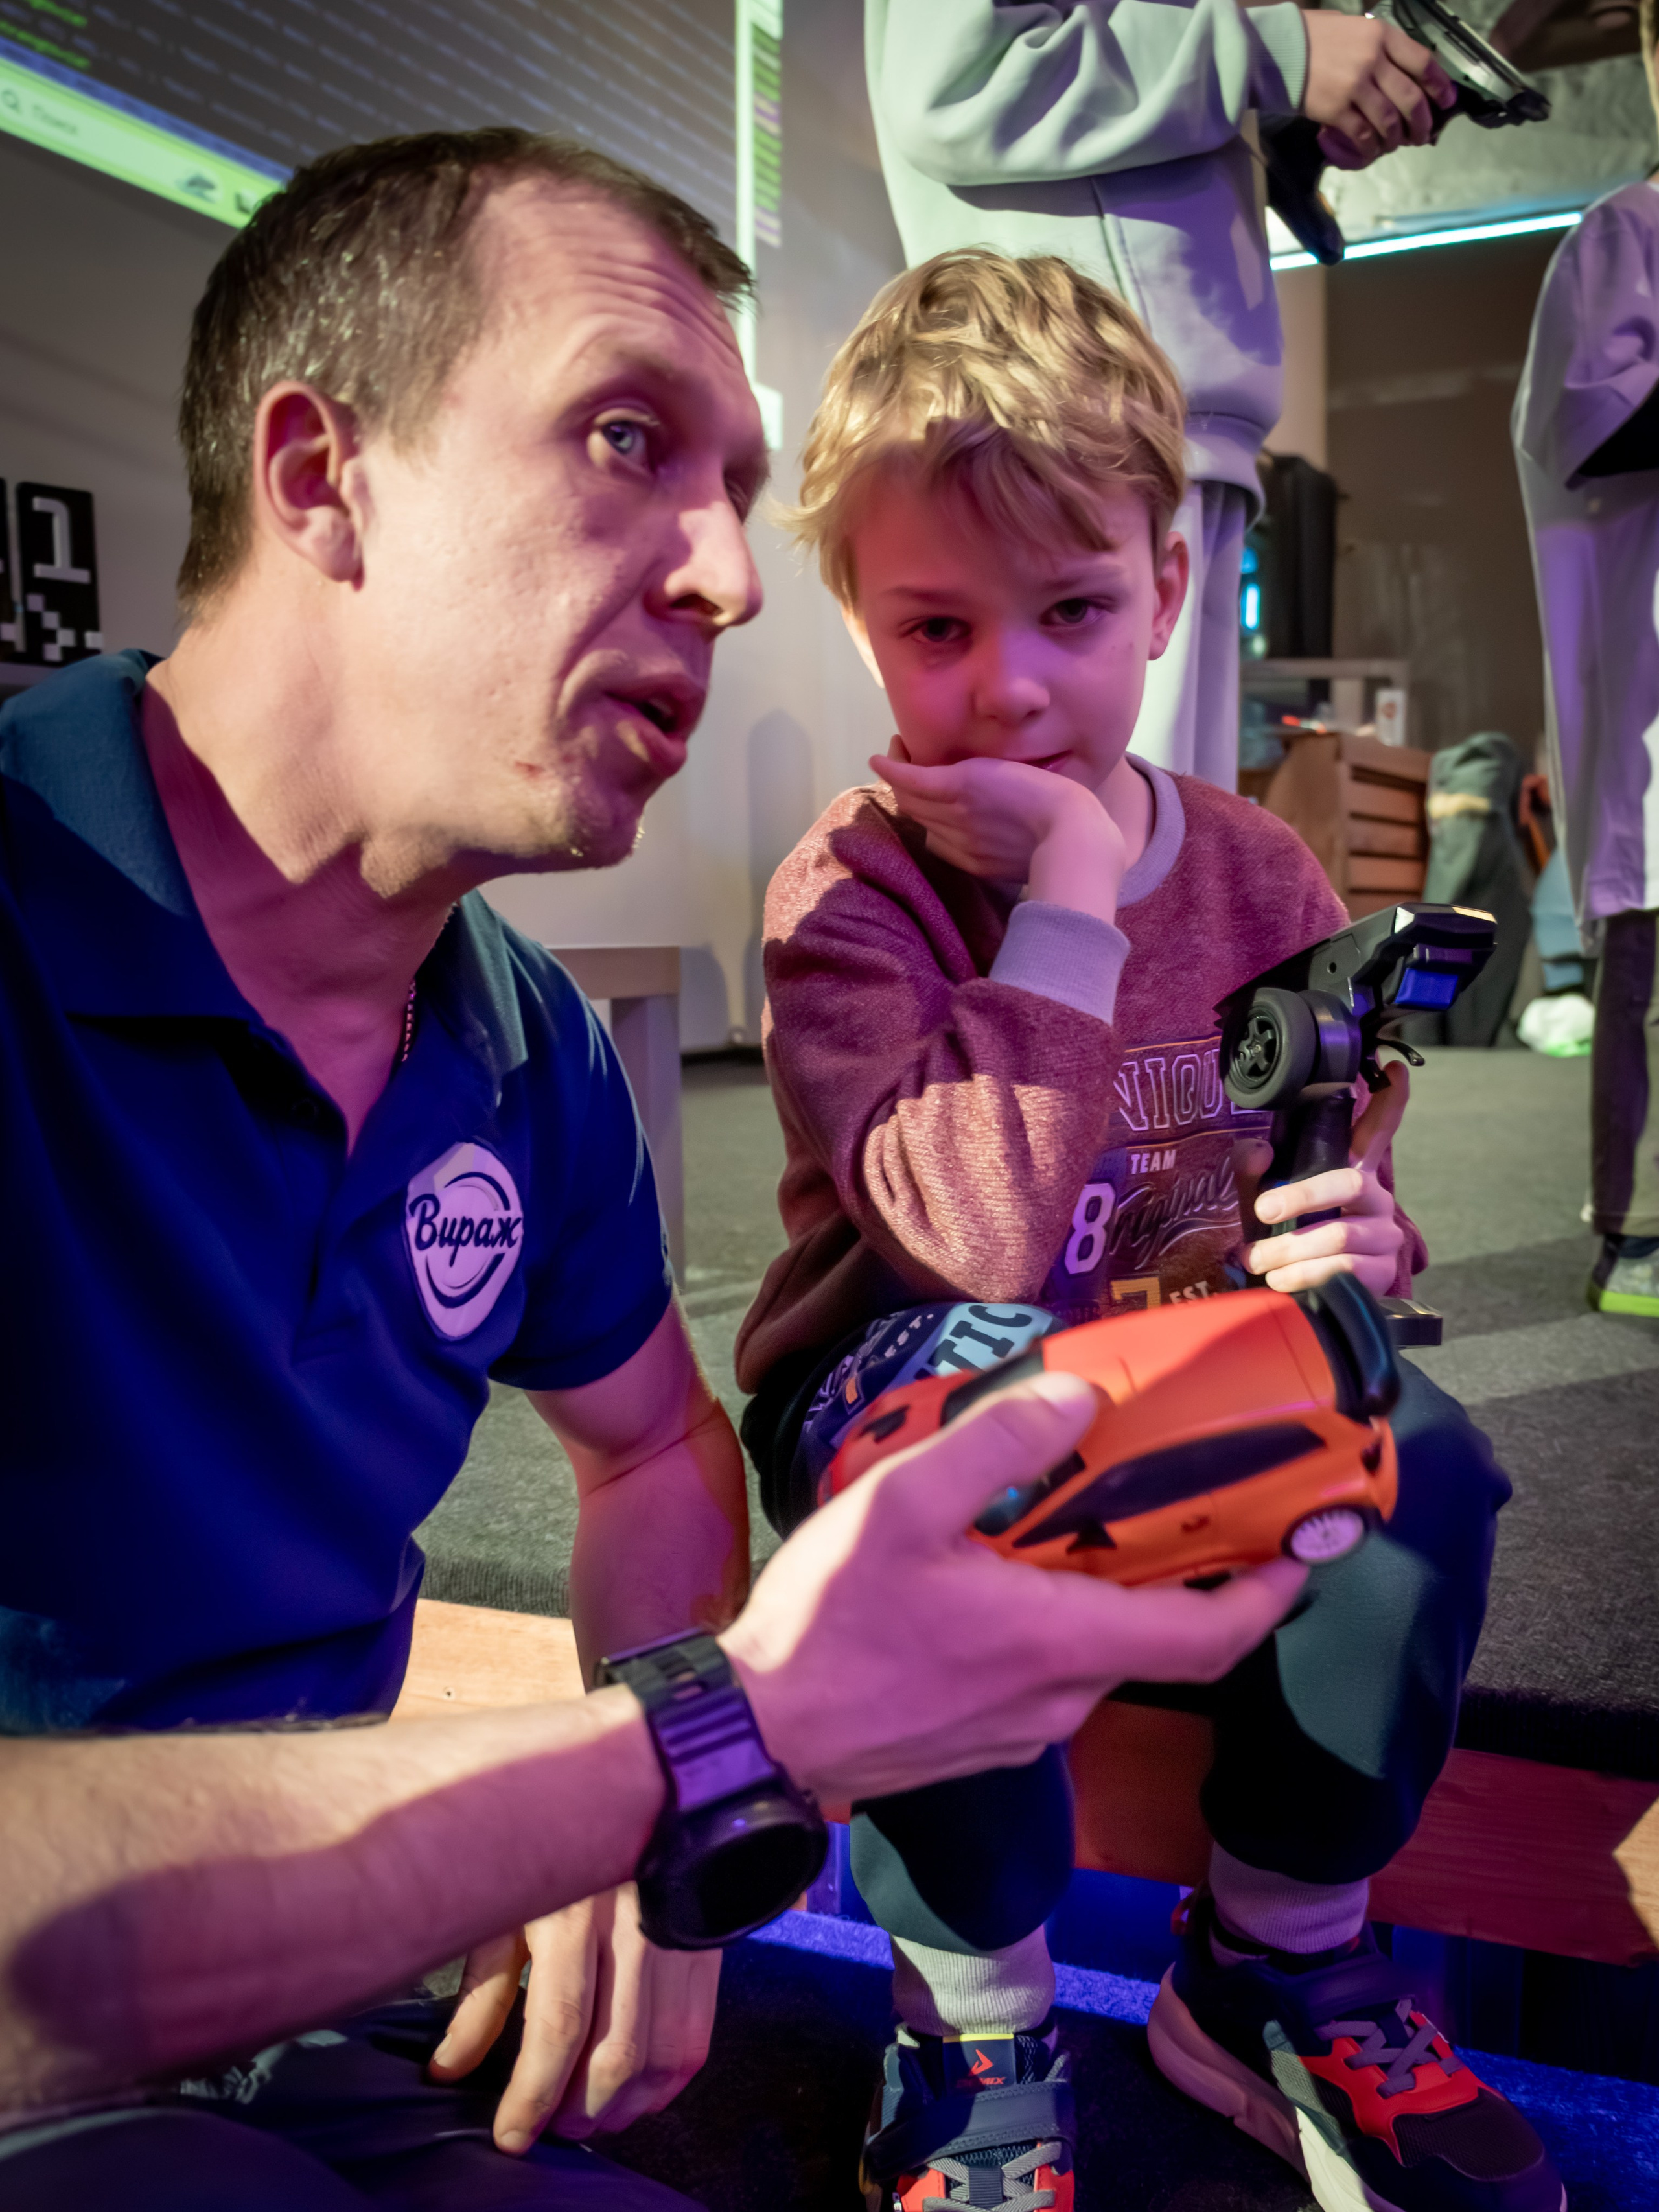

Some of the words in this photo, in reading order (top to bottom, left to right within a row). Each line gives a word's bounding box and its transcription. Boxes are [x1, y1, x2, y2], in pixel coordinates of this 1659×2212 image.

[1130, 1149, 1177, 1175] TEAM
[408, 1193, 522, 1268] Вираж
[912, 1305, 1033, 1380] TIC
